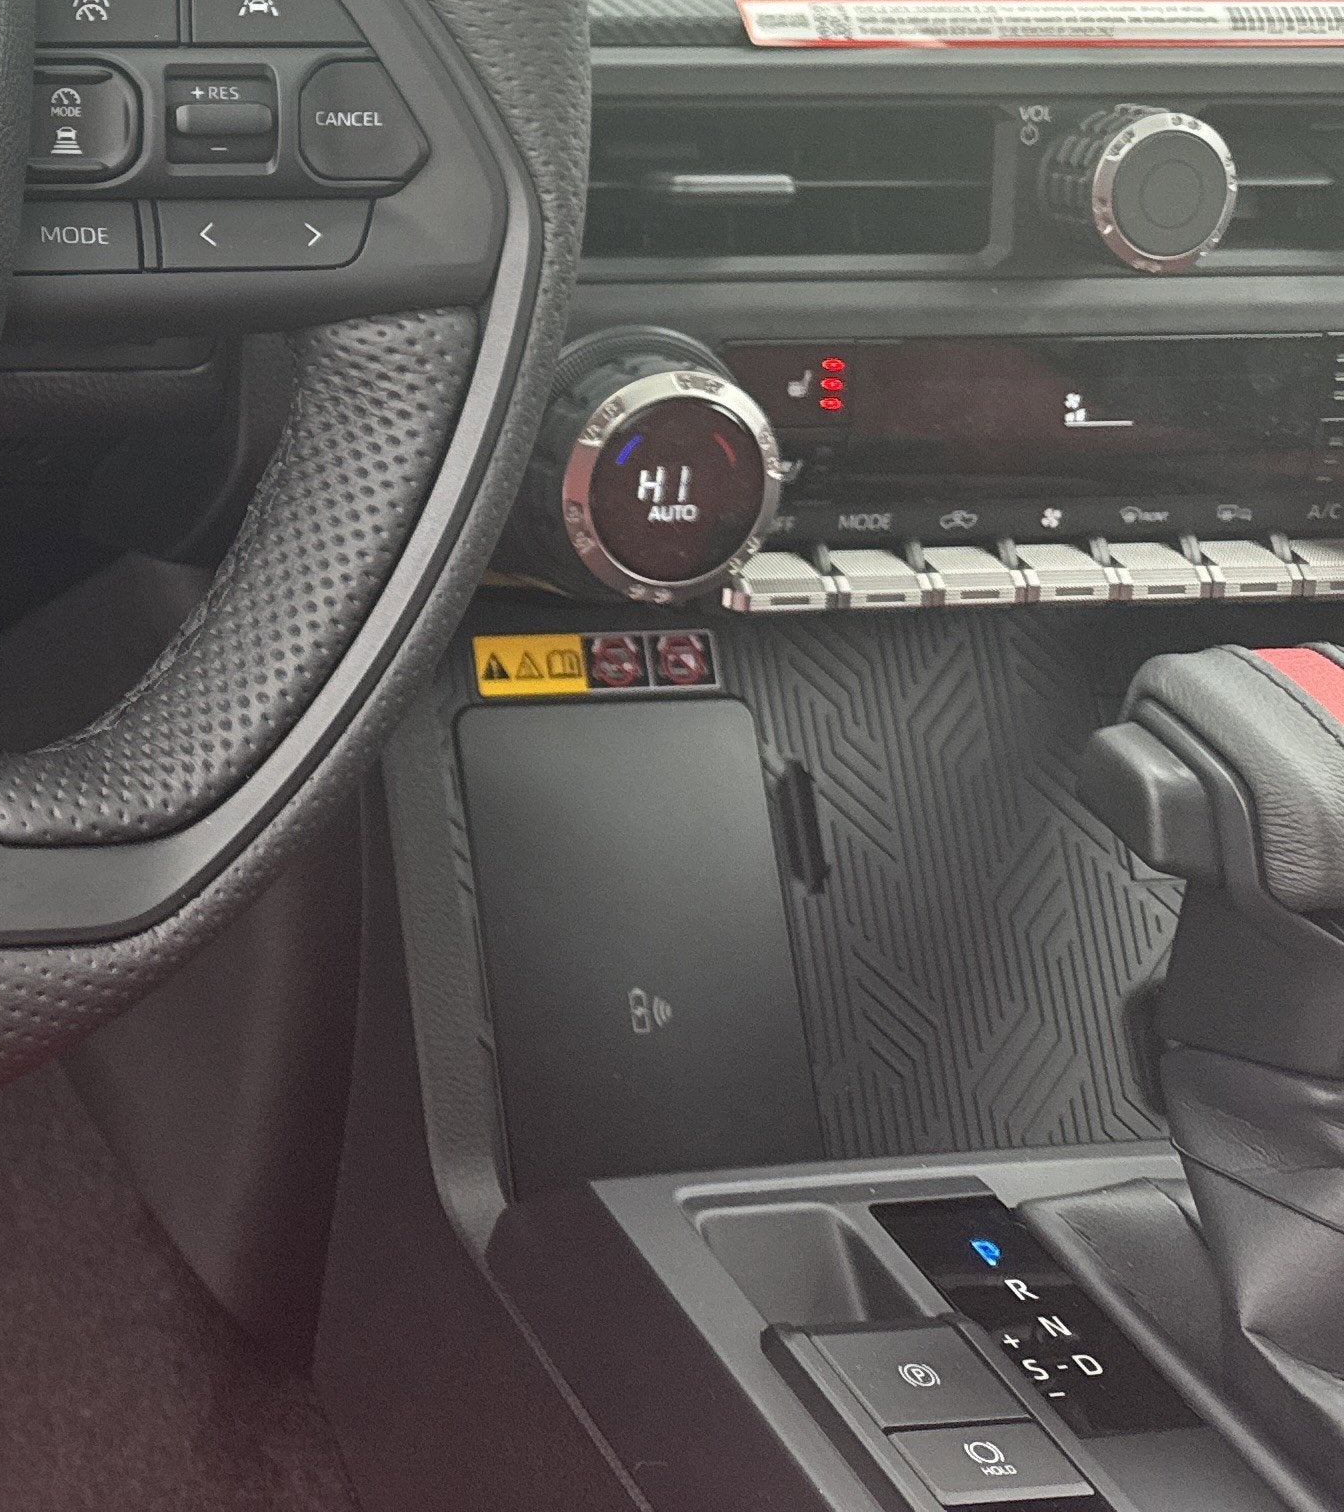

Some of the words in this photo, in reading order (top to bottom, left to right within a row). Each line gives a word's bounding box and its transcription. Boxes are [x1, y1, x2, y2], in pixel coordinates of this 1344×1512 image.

[50, 105, 83, 118] MODE
[315, 110, 384, 128] CANCEL
[1019, 104, 1052, 123] VOL
[40, 225, 110, 246] MODE
[636, 464, 692, 504] HI
[647, 504, 699, 523] AUTO
[838, 513, 892, 531] MODE
[1004, 1278, 1040, 1301] R
[1037, 1315, 1073, 1338] N
[1022, 1358, 1050, 1381] S
[1071, 1354, 1104, 1376] D
[980, 1464, 1018, 1477] HOLD
